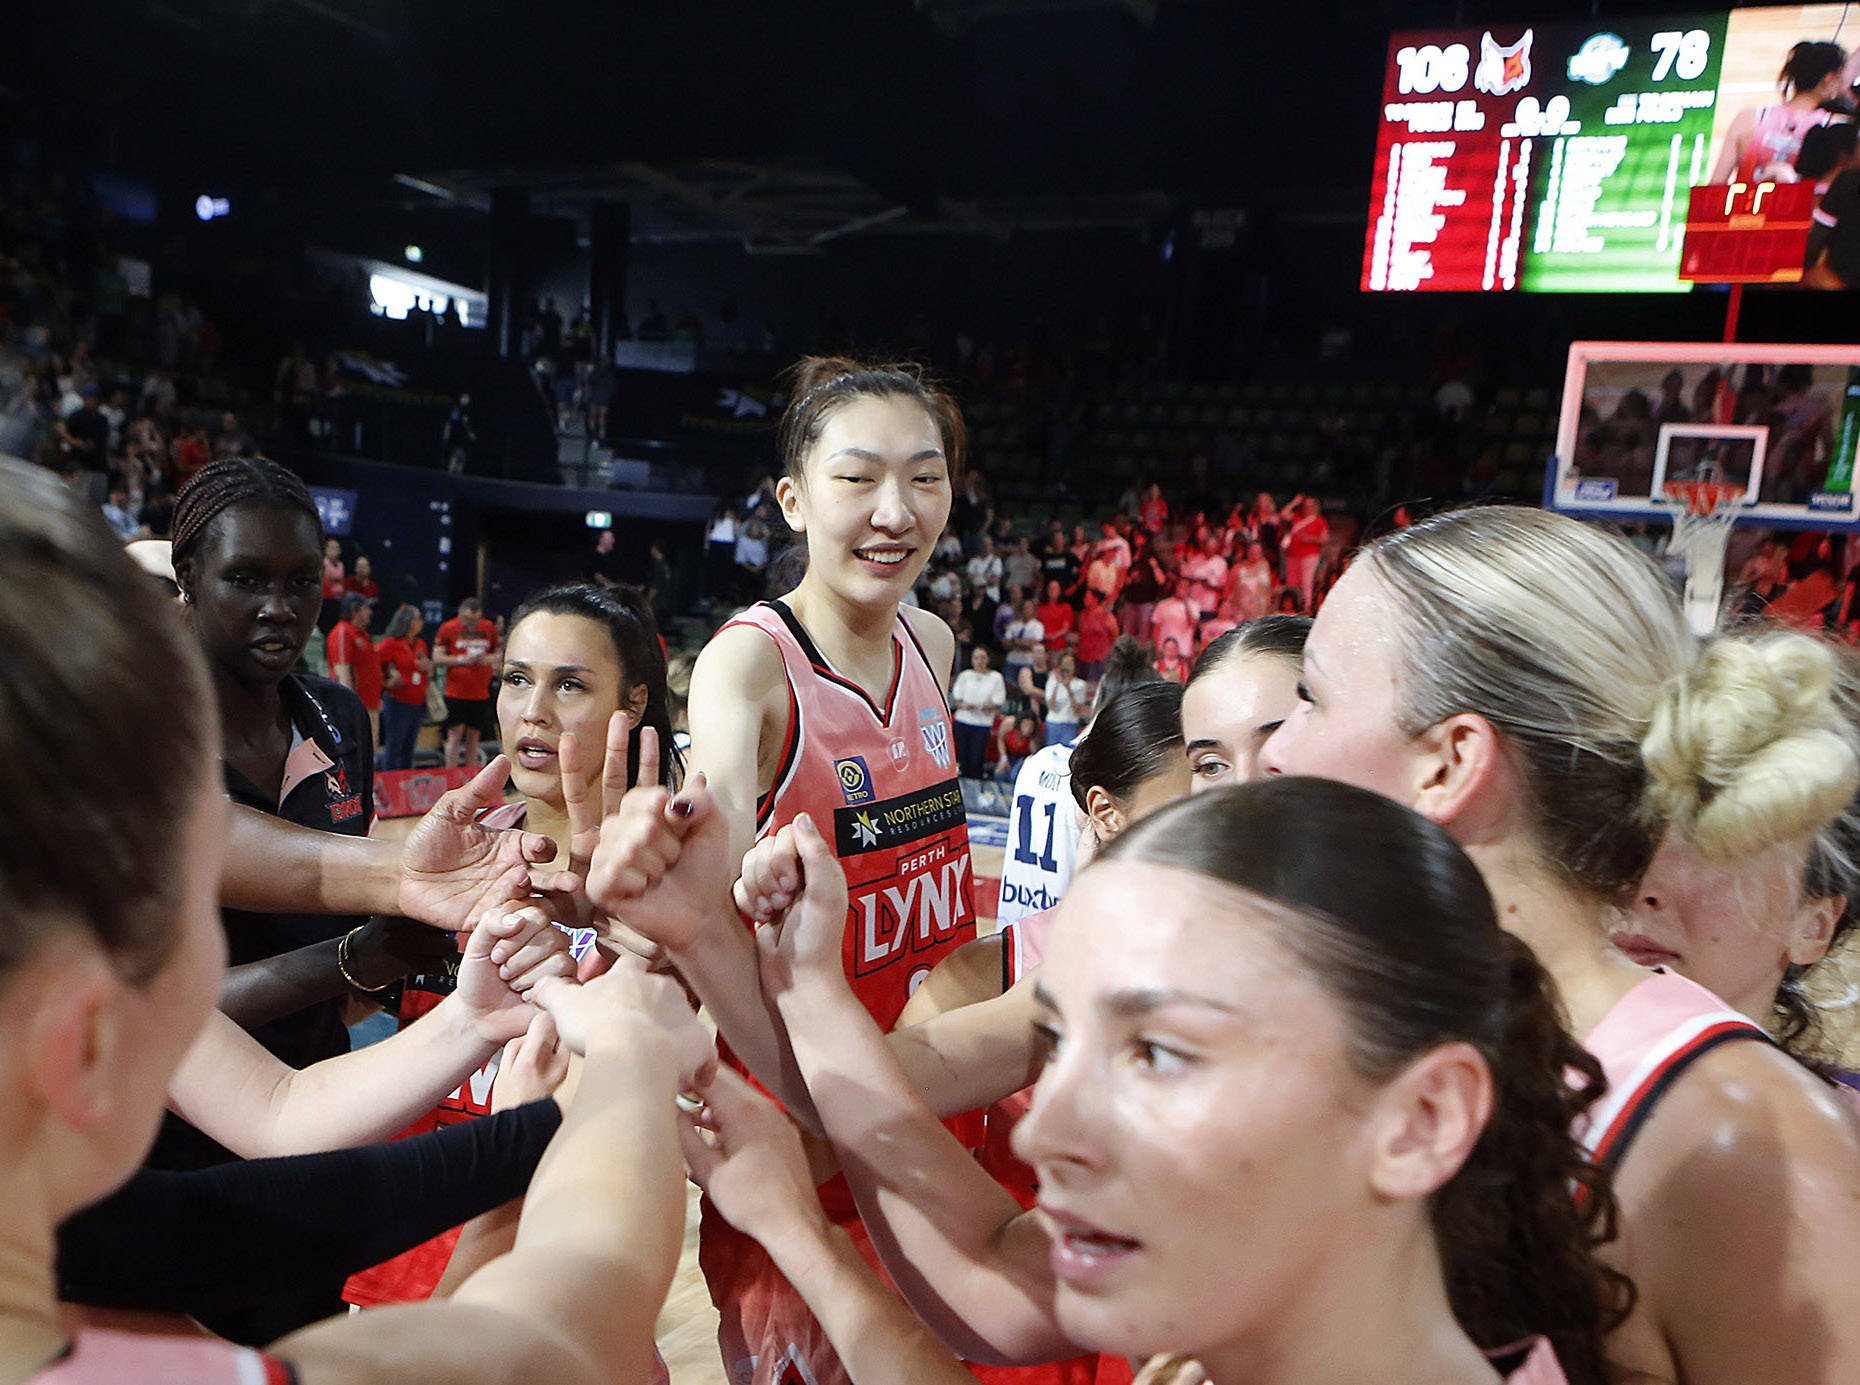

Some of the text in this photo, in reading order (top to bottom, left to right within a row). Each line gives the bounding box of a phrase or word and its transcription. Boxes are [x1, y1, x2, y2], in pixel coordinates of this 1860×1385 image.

[1650, 29, 1711, 81] 78
[883, 795, 944, 825] NORTHERN
[942, 789, 962, 807] STA
[889, 810, 952, 836] RESOURCES
[1014, 794, 1058, 873] 11
[901, 846, 946, 875] PERTH
[858, 853, 969, 962] LYNX
